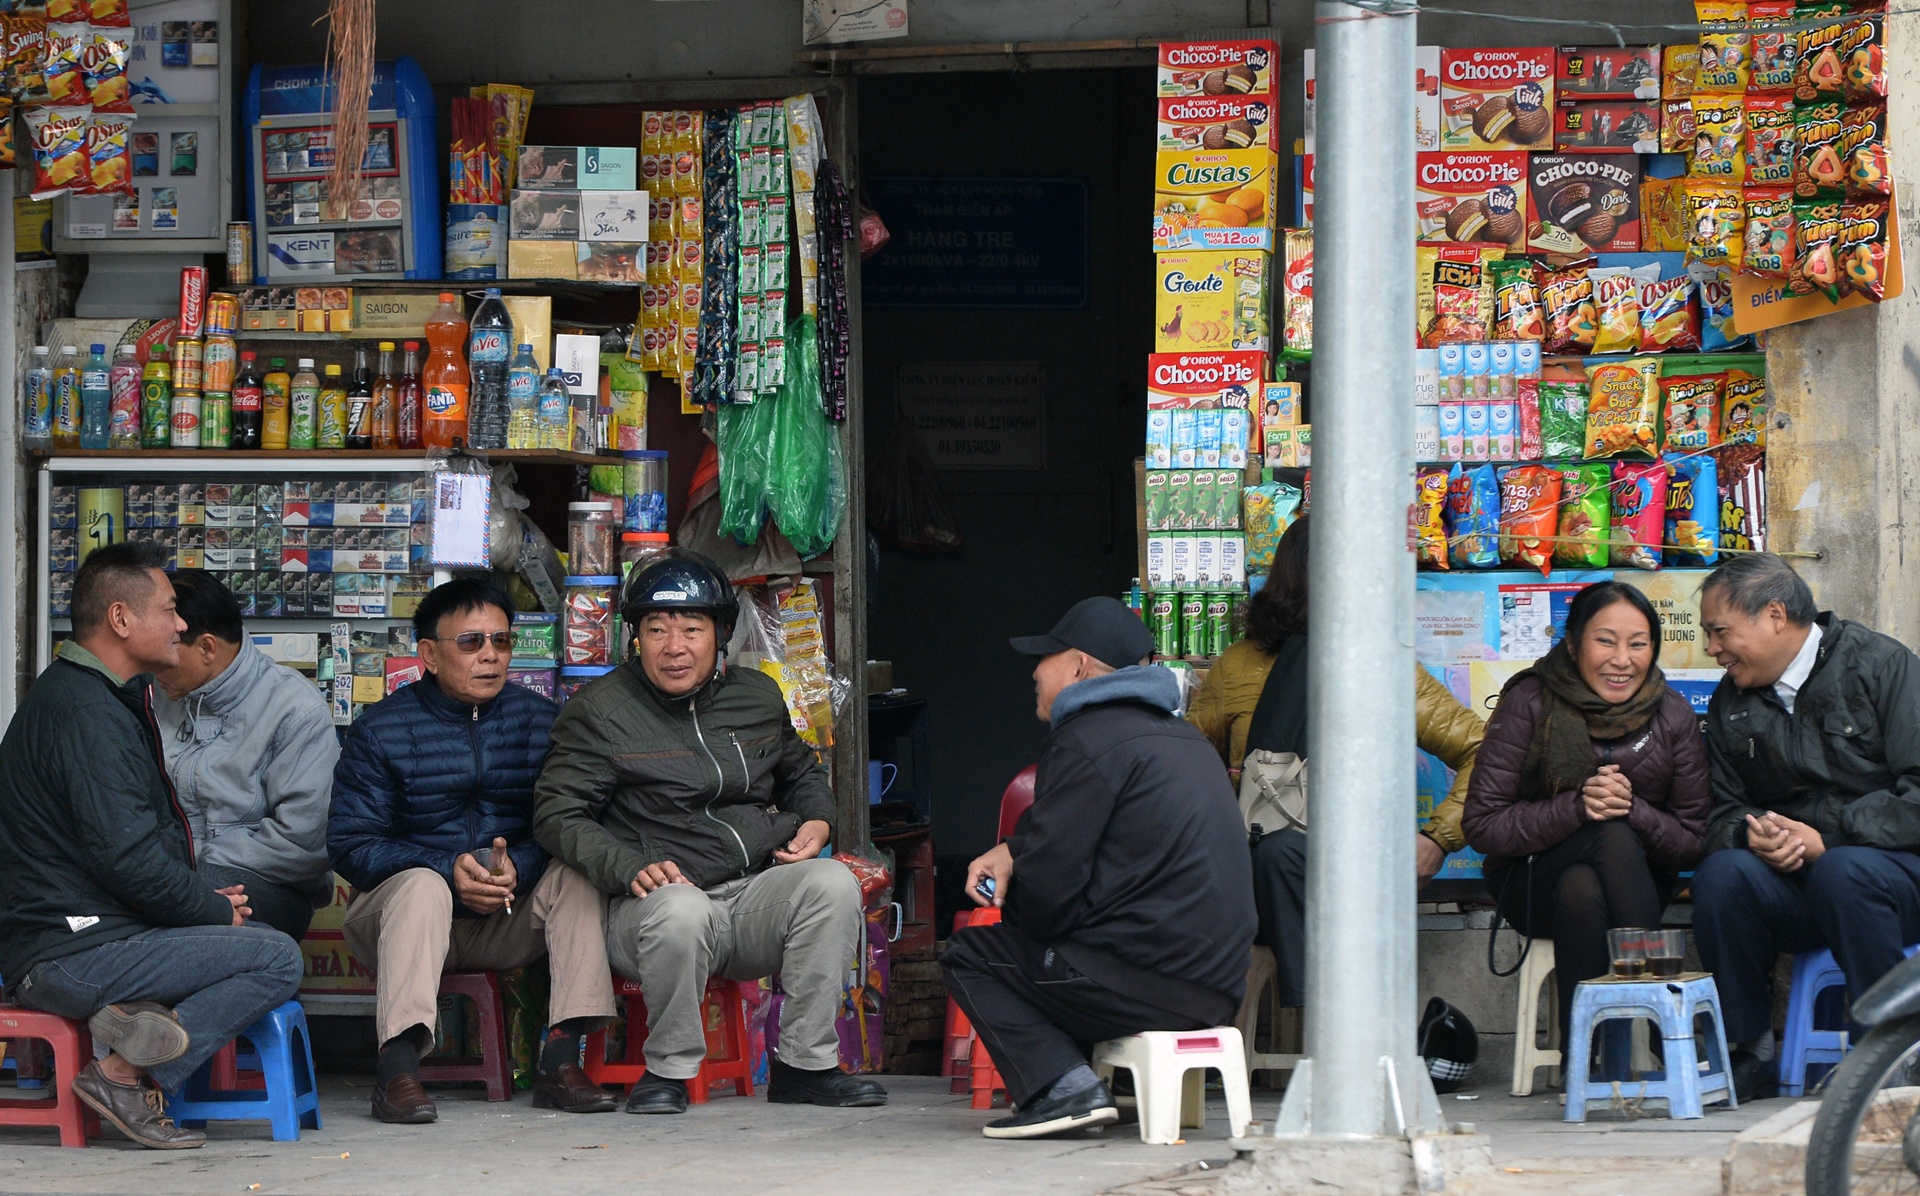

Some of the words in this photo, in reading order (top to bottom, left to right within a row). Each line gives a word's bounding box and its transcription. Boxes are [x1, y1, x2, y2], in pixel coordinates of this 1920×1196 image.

[9, 30, 43, 57] Swing
[1483, 52, 1517, 61] ORION
[1712, 72, 1738, 86] 108
[1766, 70, 1792, 85] 108
[1458, 156, 1490, 164] ORION
[1168, 163, 1251, 186] Custas
[1706, 163, 1733, 175] 108
[1763, 163, 1791, 178] 108
[1601, 191, 1631, 211] Dark
[908, 227, 967, 247] HÀNG
[973, 231, 1014, 247] TRE
[1205, 232, 1222, 240] MUA
[1223, 233, 1240, 244] 12
[1241, 236, 1260, 245] GÓI
[1555, 231, 1572, 243] 70%
[286, 240, 330, 251] KENT
[1755, 256, 1782, 269] 108
[1164, 271, 1224, 293] Gouté
[1641, 274, 1688, 310] O'Star
[366, 303, 408, 314] SAIGON
[1190, 356, 1223, 365] ORION
[1602, 378, 1642, 393] Snack
[427, 391, 457, 406] FANTA
[1267, 389, 1288, 397] Fami
[29, 375, 38, 427] Revive
[60, 374, 71, 426] Revive
[177, 416, 192, 425] 333
[1267, 432, 1288, 440] Fami
[1149, 476, 1165, 484] MILO
[1172, 476, 1188, 484] MILO
[1195, 475, 1212, 484] MILO
[1219, 475, 1235, 484] MILO
[1660, 600, 1673, 608] NĂM
[1669, 610, 1692, 625] THỨC
[1664, 629, 1695, 644] LƯỢNG
